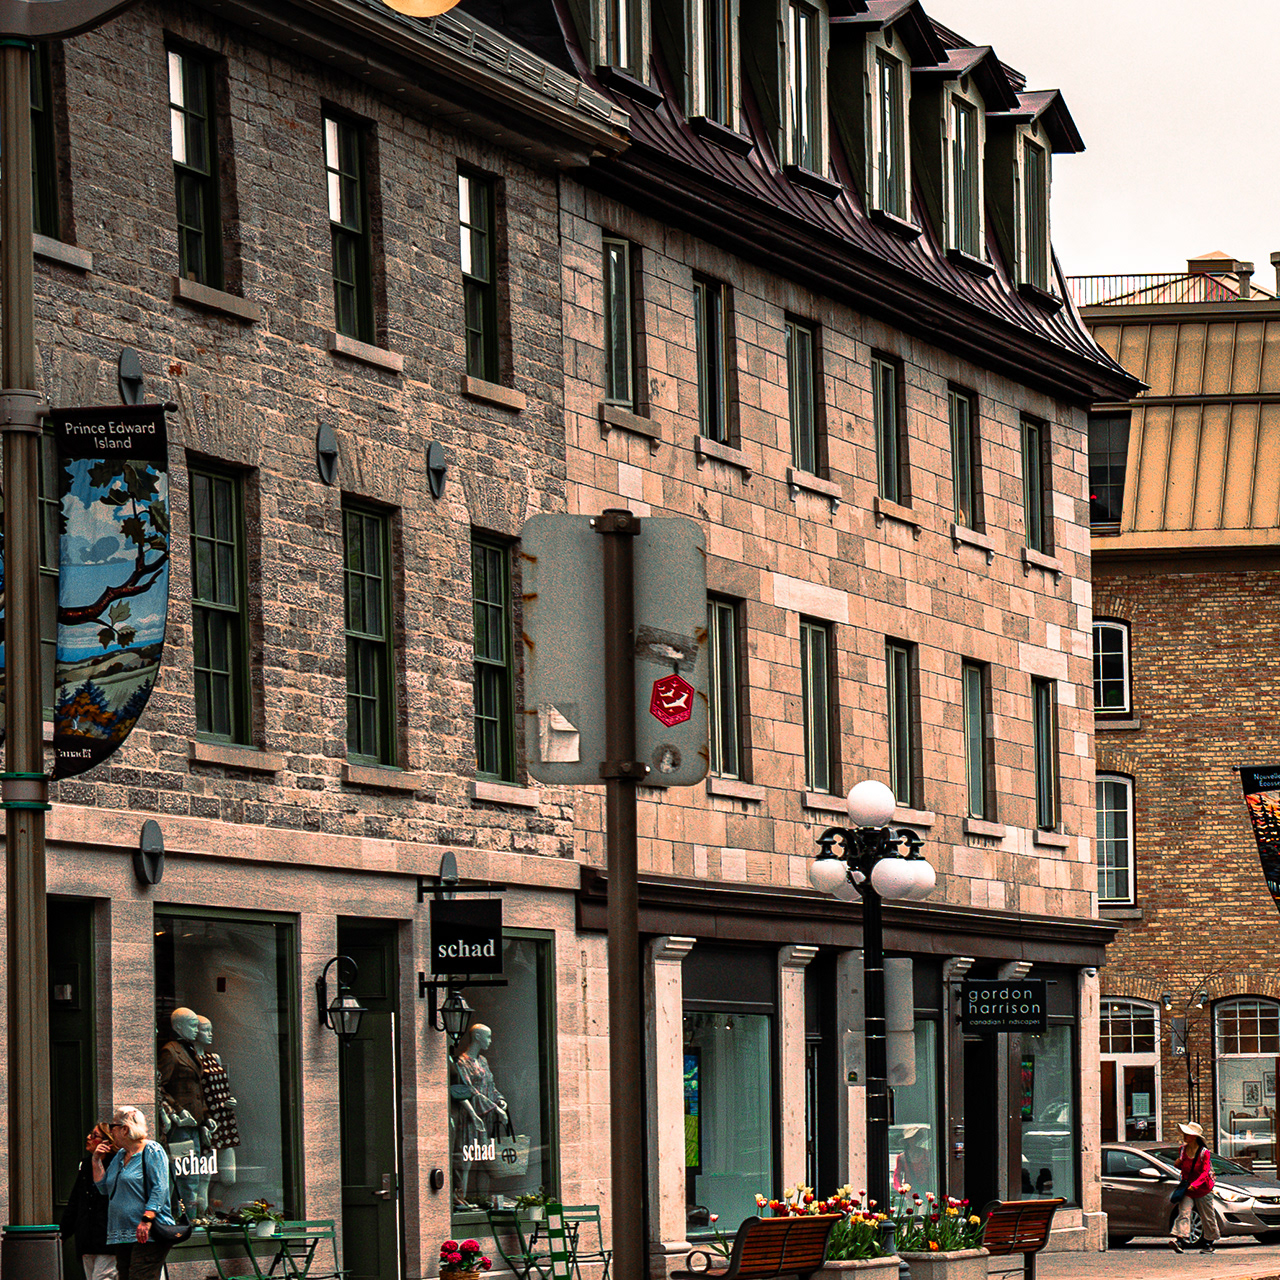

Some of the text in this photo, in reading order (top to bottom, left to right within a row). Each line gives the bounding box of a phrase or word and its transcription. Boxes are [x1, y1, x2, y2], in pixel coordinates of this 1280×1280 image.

[65, 421, 155, 434] Prince Edward
[94, 436, 132, 448] Island
[438, 938, 496, 958] schad
[968, 987, 1033, 1003] gordon
[968, 1002, 1040, 1014] harrison
[462, 1137, 496, 1161] schad
[174, 1148, 219, 1176] schad
